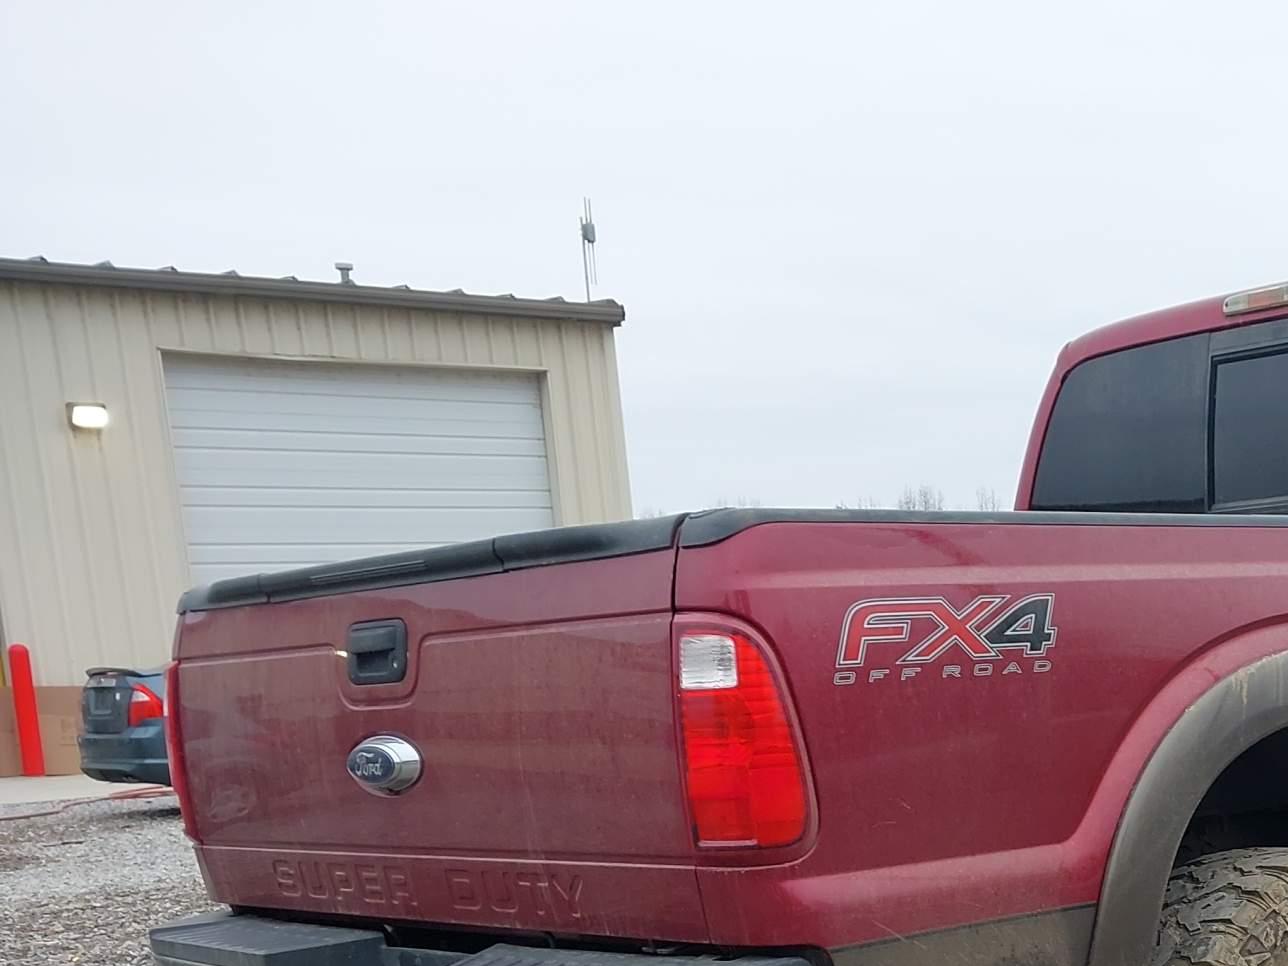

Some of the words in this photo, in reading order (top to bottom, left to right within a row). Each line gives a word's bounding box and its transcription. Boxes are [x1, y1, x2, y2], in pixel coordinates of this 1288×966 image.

[836, 593, 1057, 667] FX4
[833, 667, 922, 685] OFF
[942, 660, 1052, 679] ROAD
[354, 752, 383, 776] Ford
[272, 859, 418, 905] SUPER
[444, 868, 584, 918] DUTY
